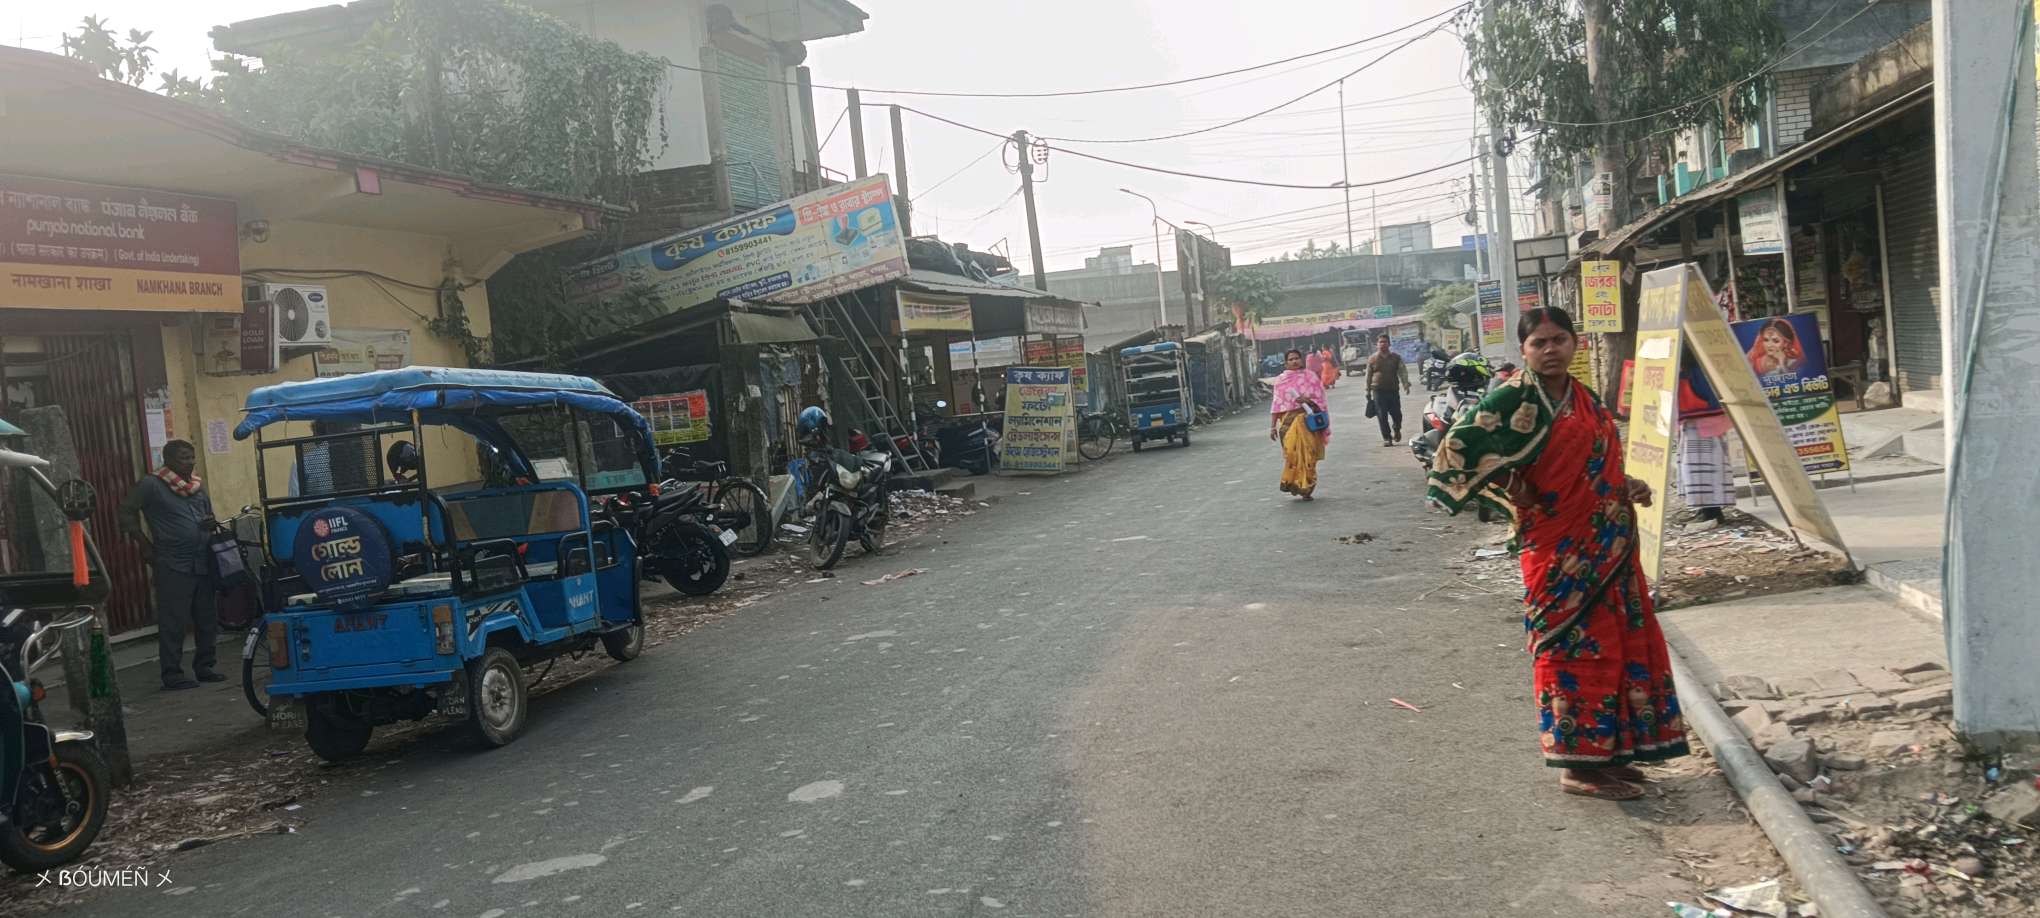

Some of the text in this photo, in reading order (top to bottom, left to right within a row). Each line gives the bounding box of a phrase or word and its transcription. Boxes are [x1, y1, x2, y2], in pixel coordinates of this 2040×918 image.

[101, 198, 136, 218] पंजाब
[27, 217, 145, 240] punjab national bank
[145, 250, 160, 262] India
[664, 234, 705, 260] কৃষ
[10, 273, 112, 292] नामखाना शाखा
[136, 279, 223, 298] NAMKHANA BRANCH
[328, 516, 349, 529] IIFL
[312, 536, 361, 561] গোল্ড
[321, 558, 364, 581] লোন
